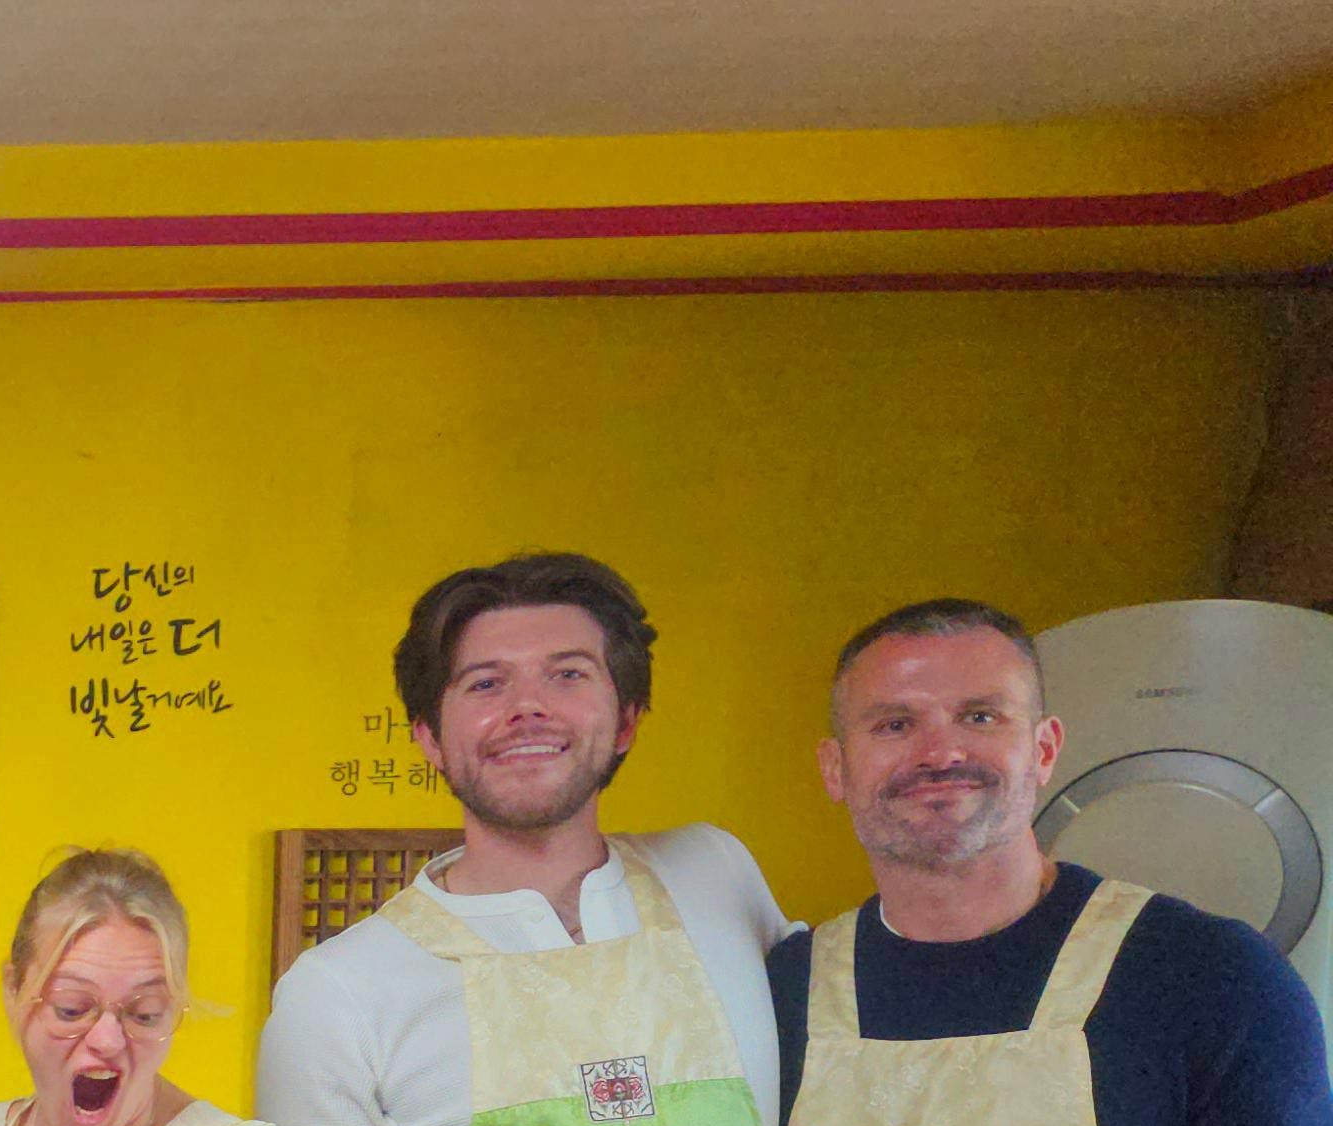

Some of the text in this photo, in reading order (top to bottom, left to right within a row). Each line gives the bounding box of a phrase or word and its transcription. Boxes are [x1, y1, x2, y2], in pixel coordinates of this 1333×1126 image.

[92, 561, 195, 613] 당신의
[70, 618, 221, 665] 내일은 더
